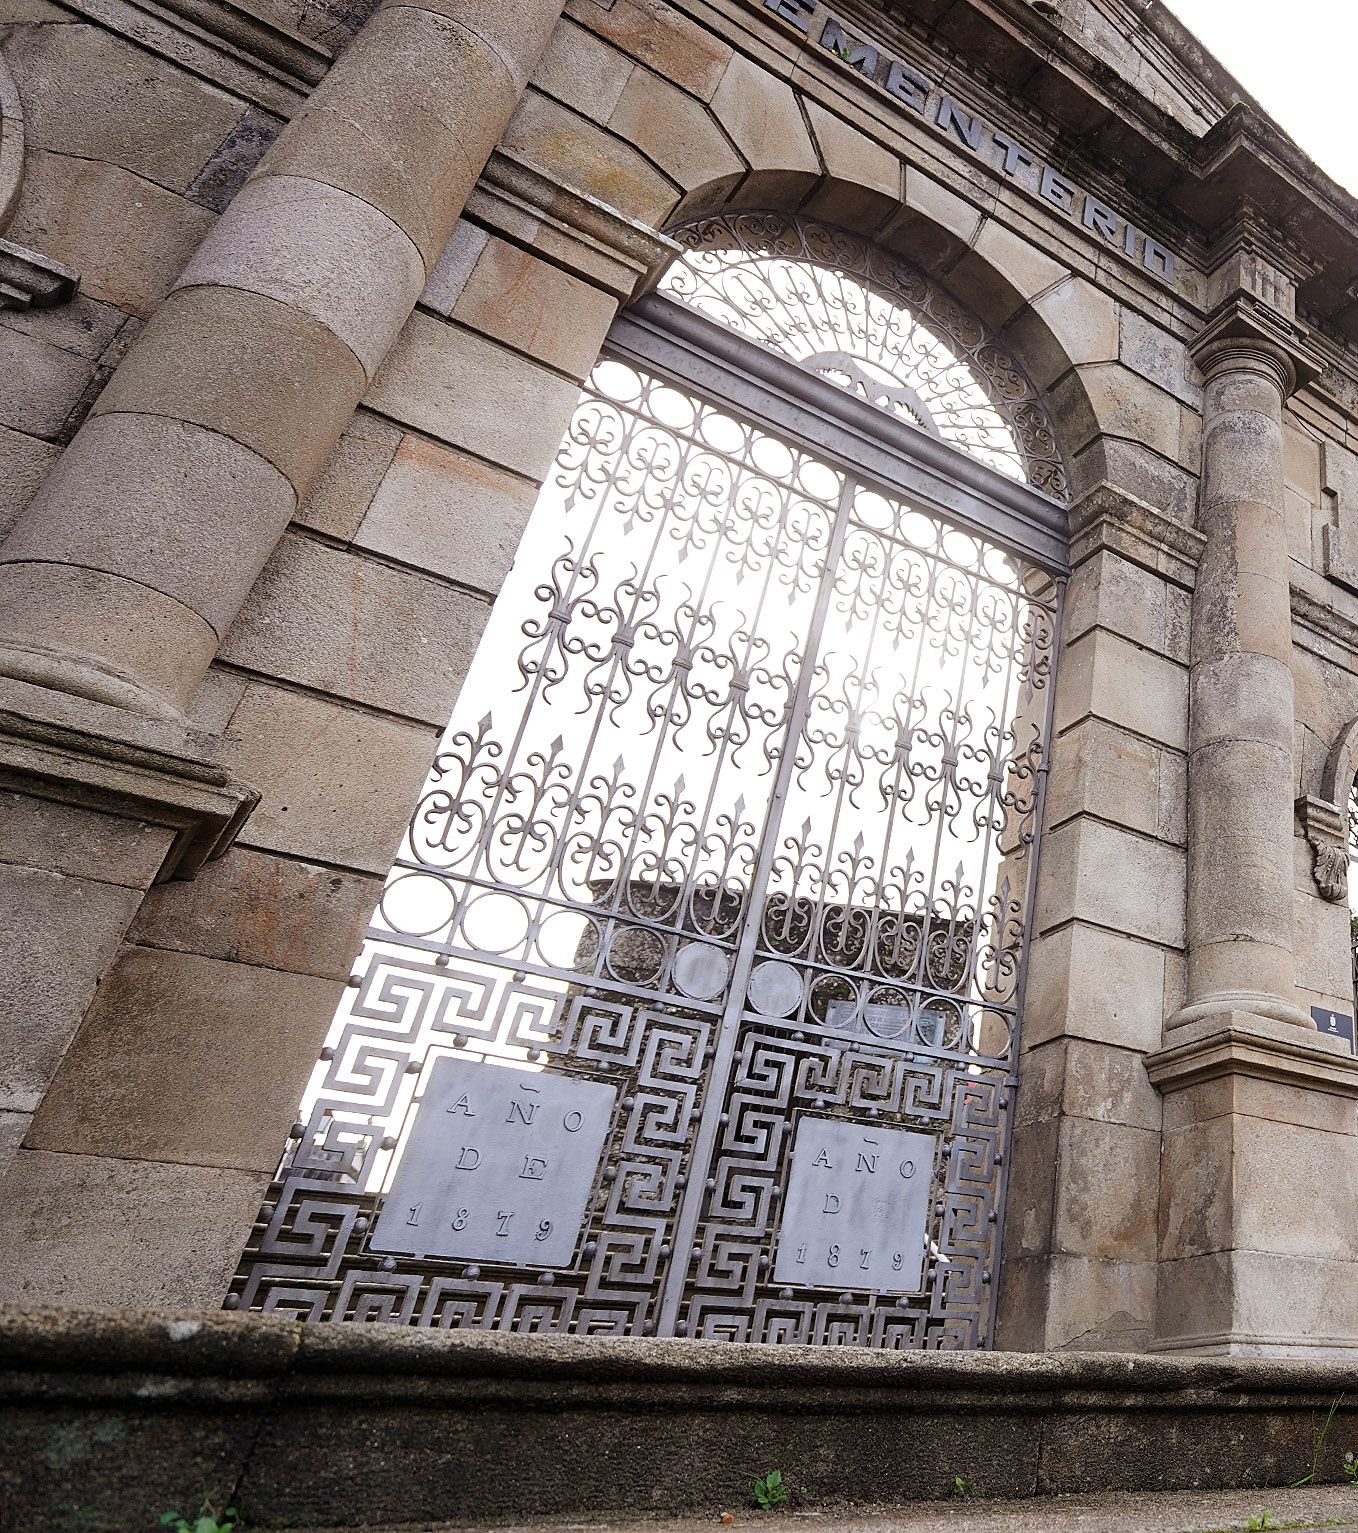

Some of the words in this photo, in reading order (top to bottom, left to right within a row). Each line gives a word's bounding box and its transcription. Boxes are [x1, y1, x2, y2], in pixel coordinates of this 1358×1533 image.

[447, 1083, 585, 1132] AÑO
[455, 1146, 548, 1180] DE
[812, 1137, 917, 1179] AÑO
[406, 1202, 553, 1241] 1879
[797, 1243, 905, 1270] 1879
